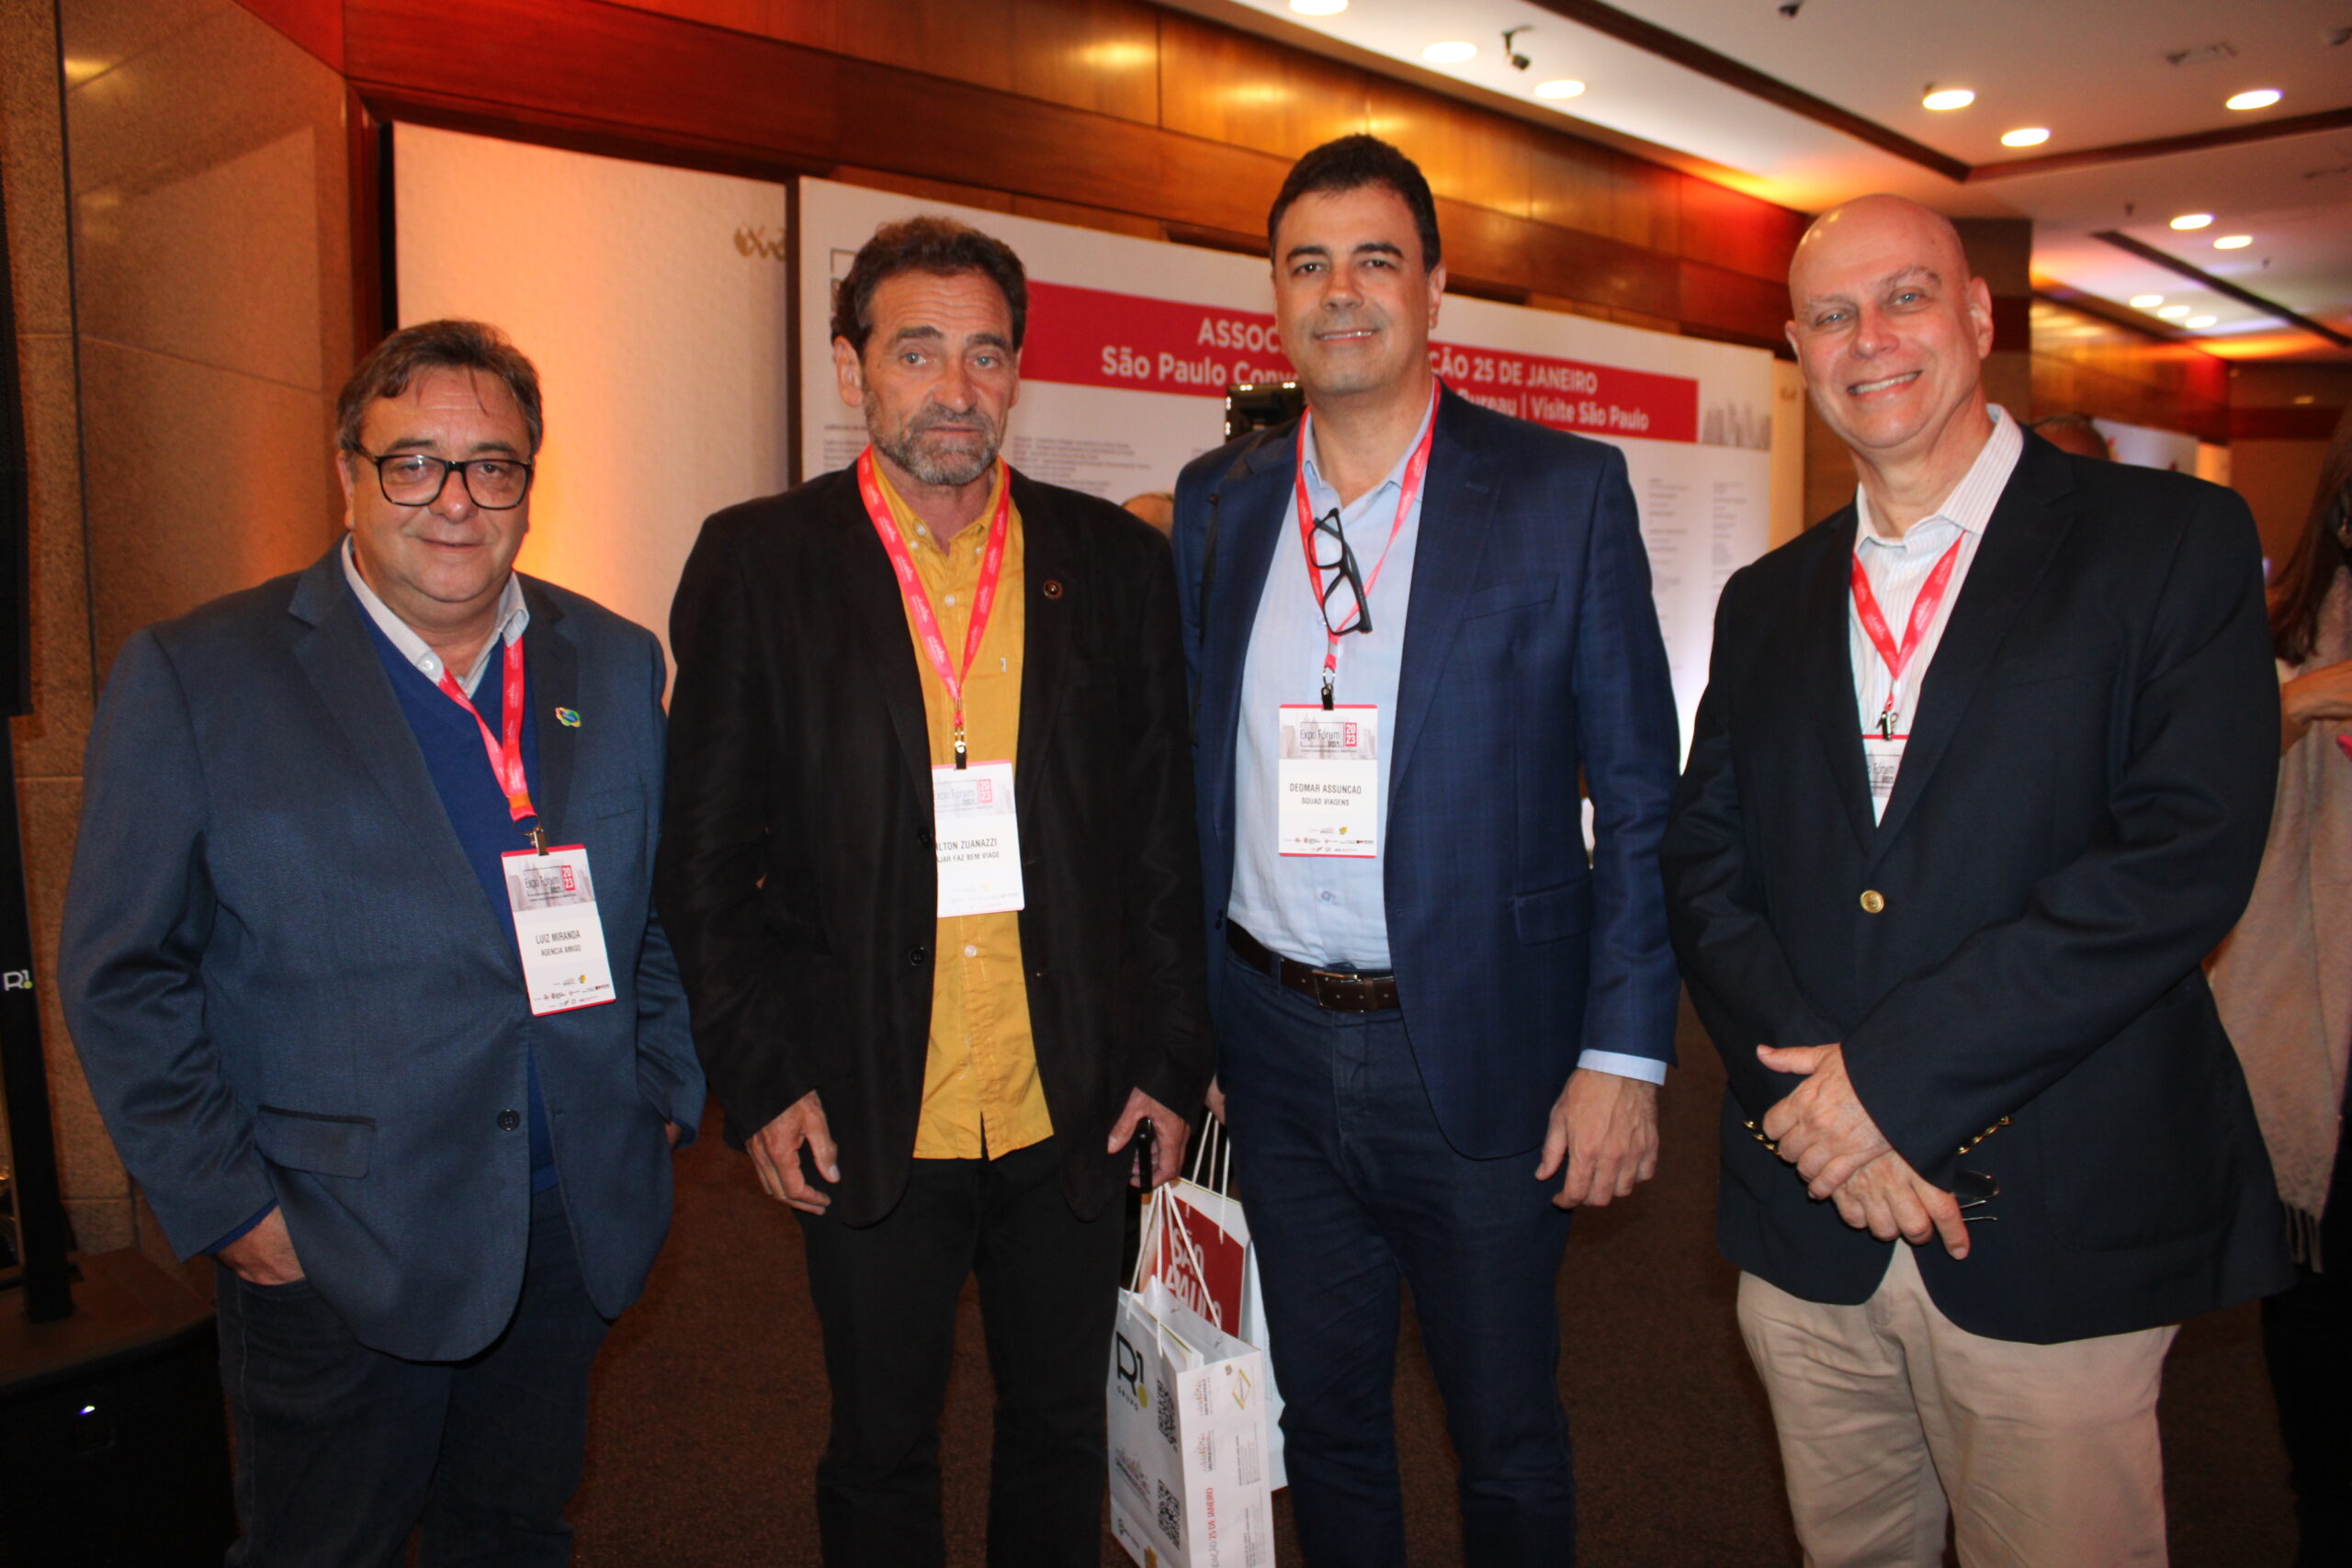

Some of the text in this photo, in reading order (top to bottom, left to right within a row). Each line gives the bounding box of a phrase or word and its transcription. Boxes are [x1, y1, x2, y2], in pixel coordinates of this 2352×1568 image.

[1197, 318, 1280, 354] ASSOC
[1472, 357, 1496, 382] 25
[1498, 361, 1523, 386] DE
[1526, 365, 1599, 395] JANEIRO
[1102, 345, 1151, 378] São
[1159, 352, 1227, 386] Paulo
[1531, 396, 1577, 423] Visite
[1578, 401, 1606, 426] São
[1610, 405, 1650, 431] Paulo
[1346, 724, 1356, 734] 20
[1346, 734, 1356, 745] 23
[1289, 783, 1362, 795] DEOMAR ASSUNCAO
[535, 930, 582, 944] LUIZ MIRANDA
